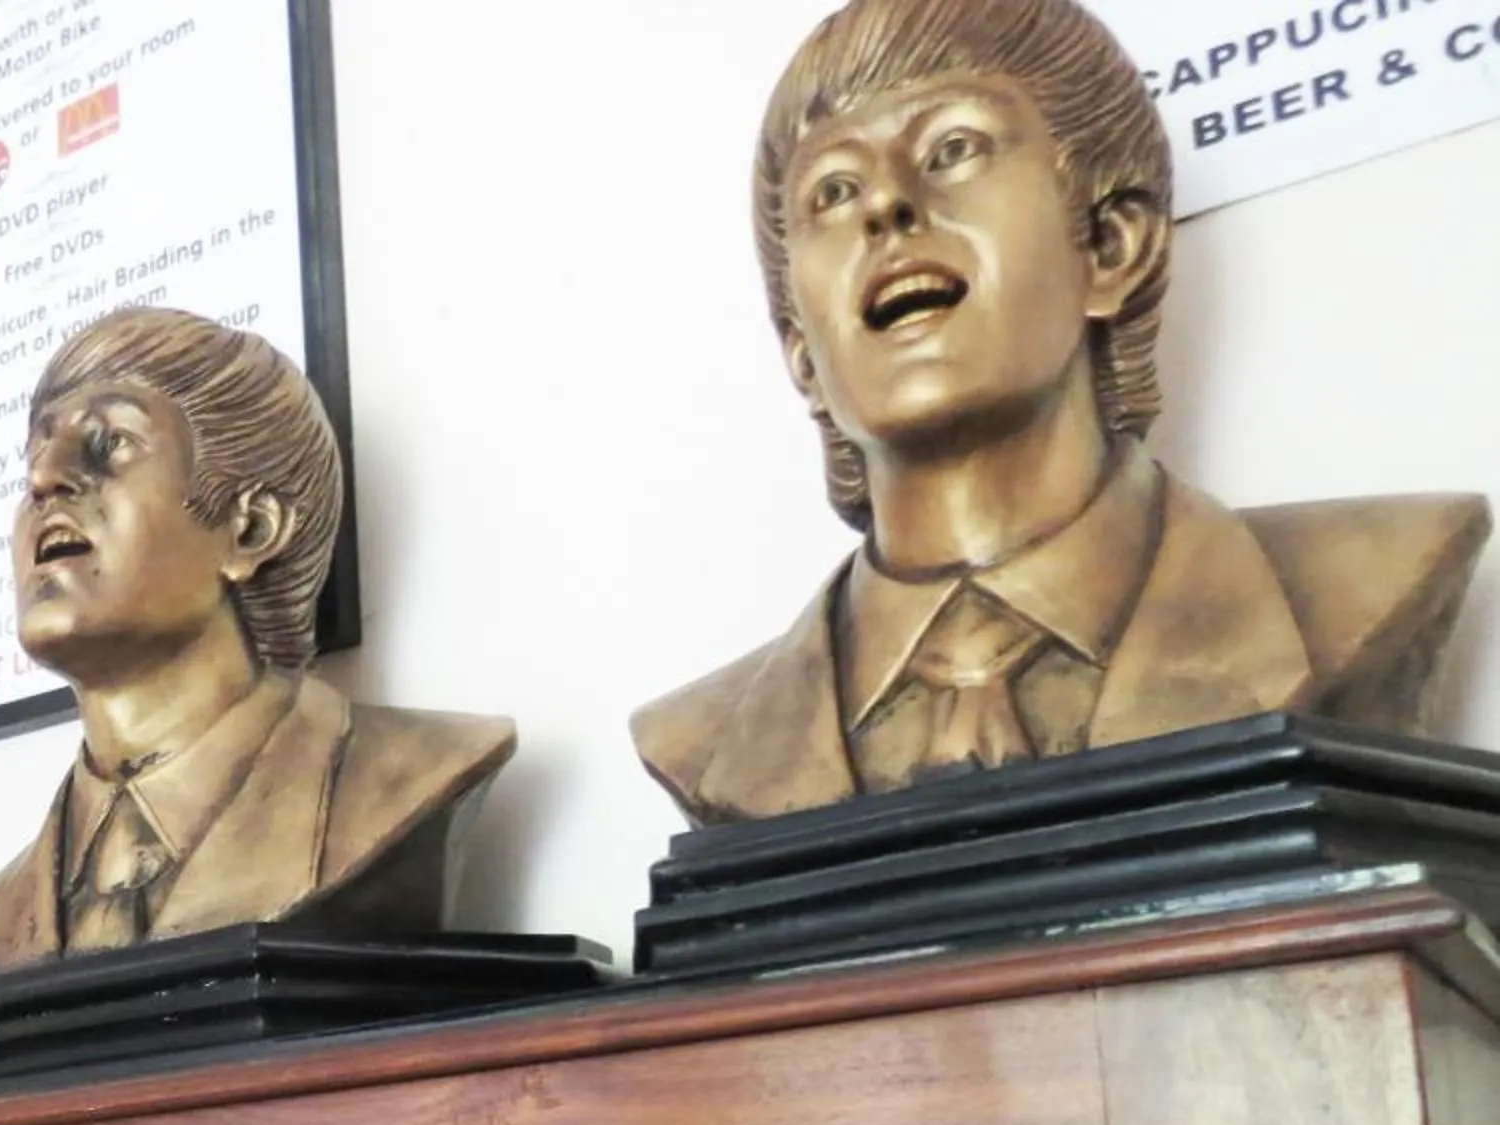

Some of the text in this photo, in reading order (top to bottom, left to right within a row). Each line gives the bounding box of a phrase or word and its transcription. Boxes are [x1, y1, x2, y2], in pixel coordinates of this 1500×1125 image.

[45, 6, 65, 28] or
[59, 15, 102, 49] Bike
[60, 77, 82, 99] to
[87, 49, 134, 89] your
[140, 18, 196, 59] room
[1192, 14, 1500, 151] BEER & C
[19, 126, 41, 149] or
[46, 174, 110, 220] player
[3, 227, 105, 285] Free DVDs
[67, 278, 108, 310] Hair
[114, 238, 204, 289] Braiding
[210, 226, 232, 248] in
[237, 208, 277, 238] the
[32, 328, 54, 353] of
[59, 307, 107, 346] your
[217, 302, 261, 333] oup
